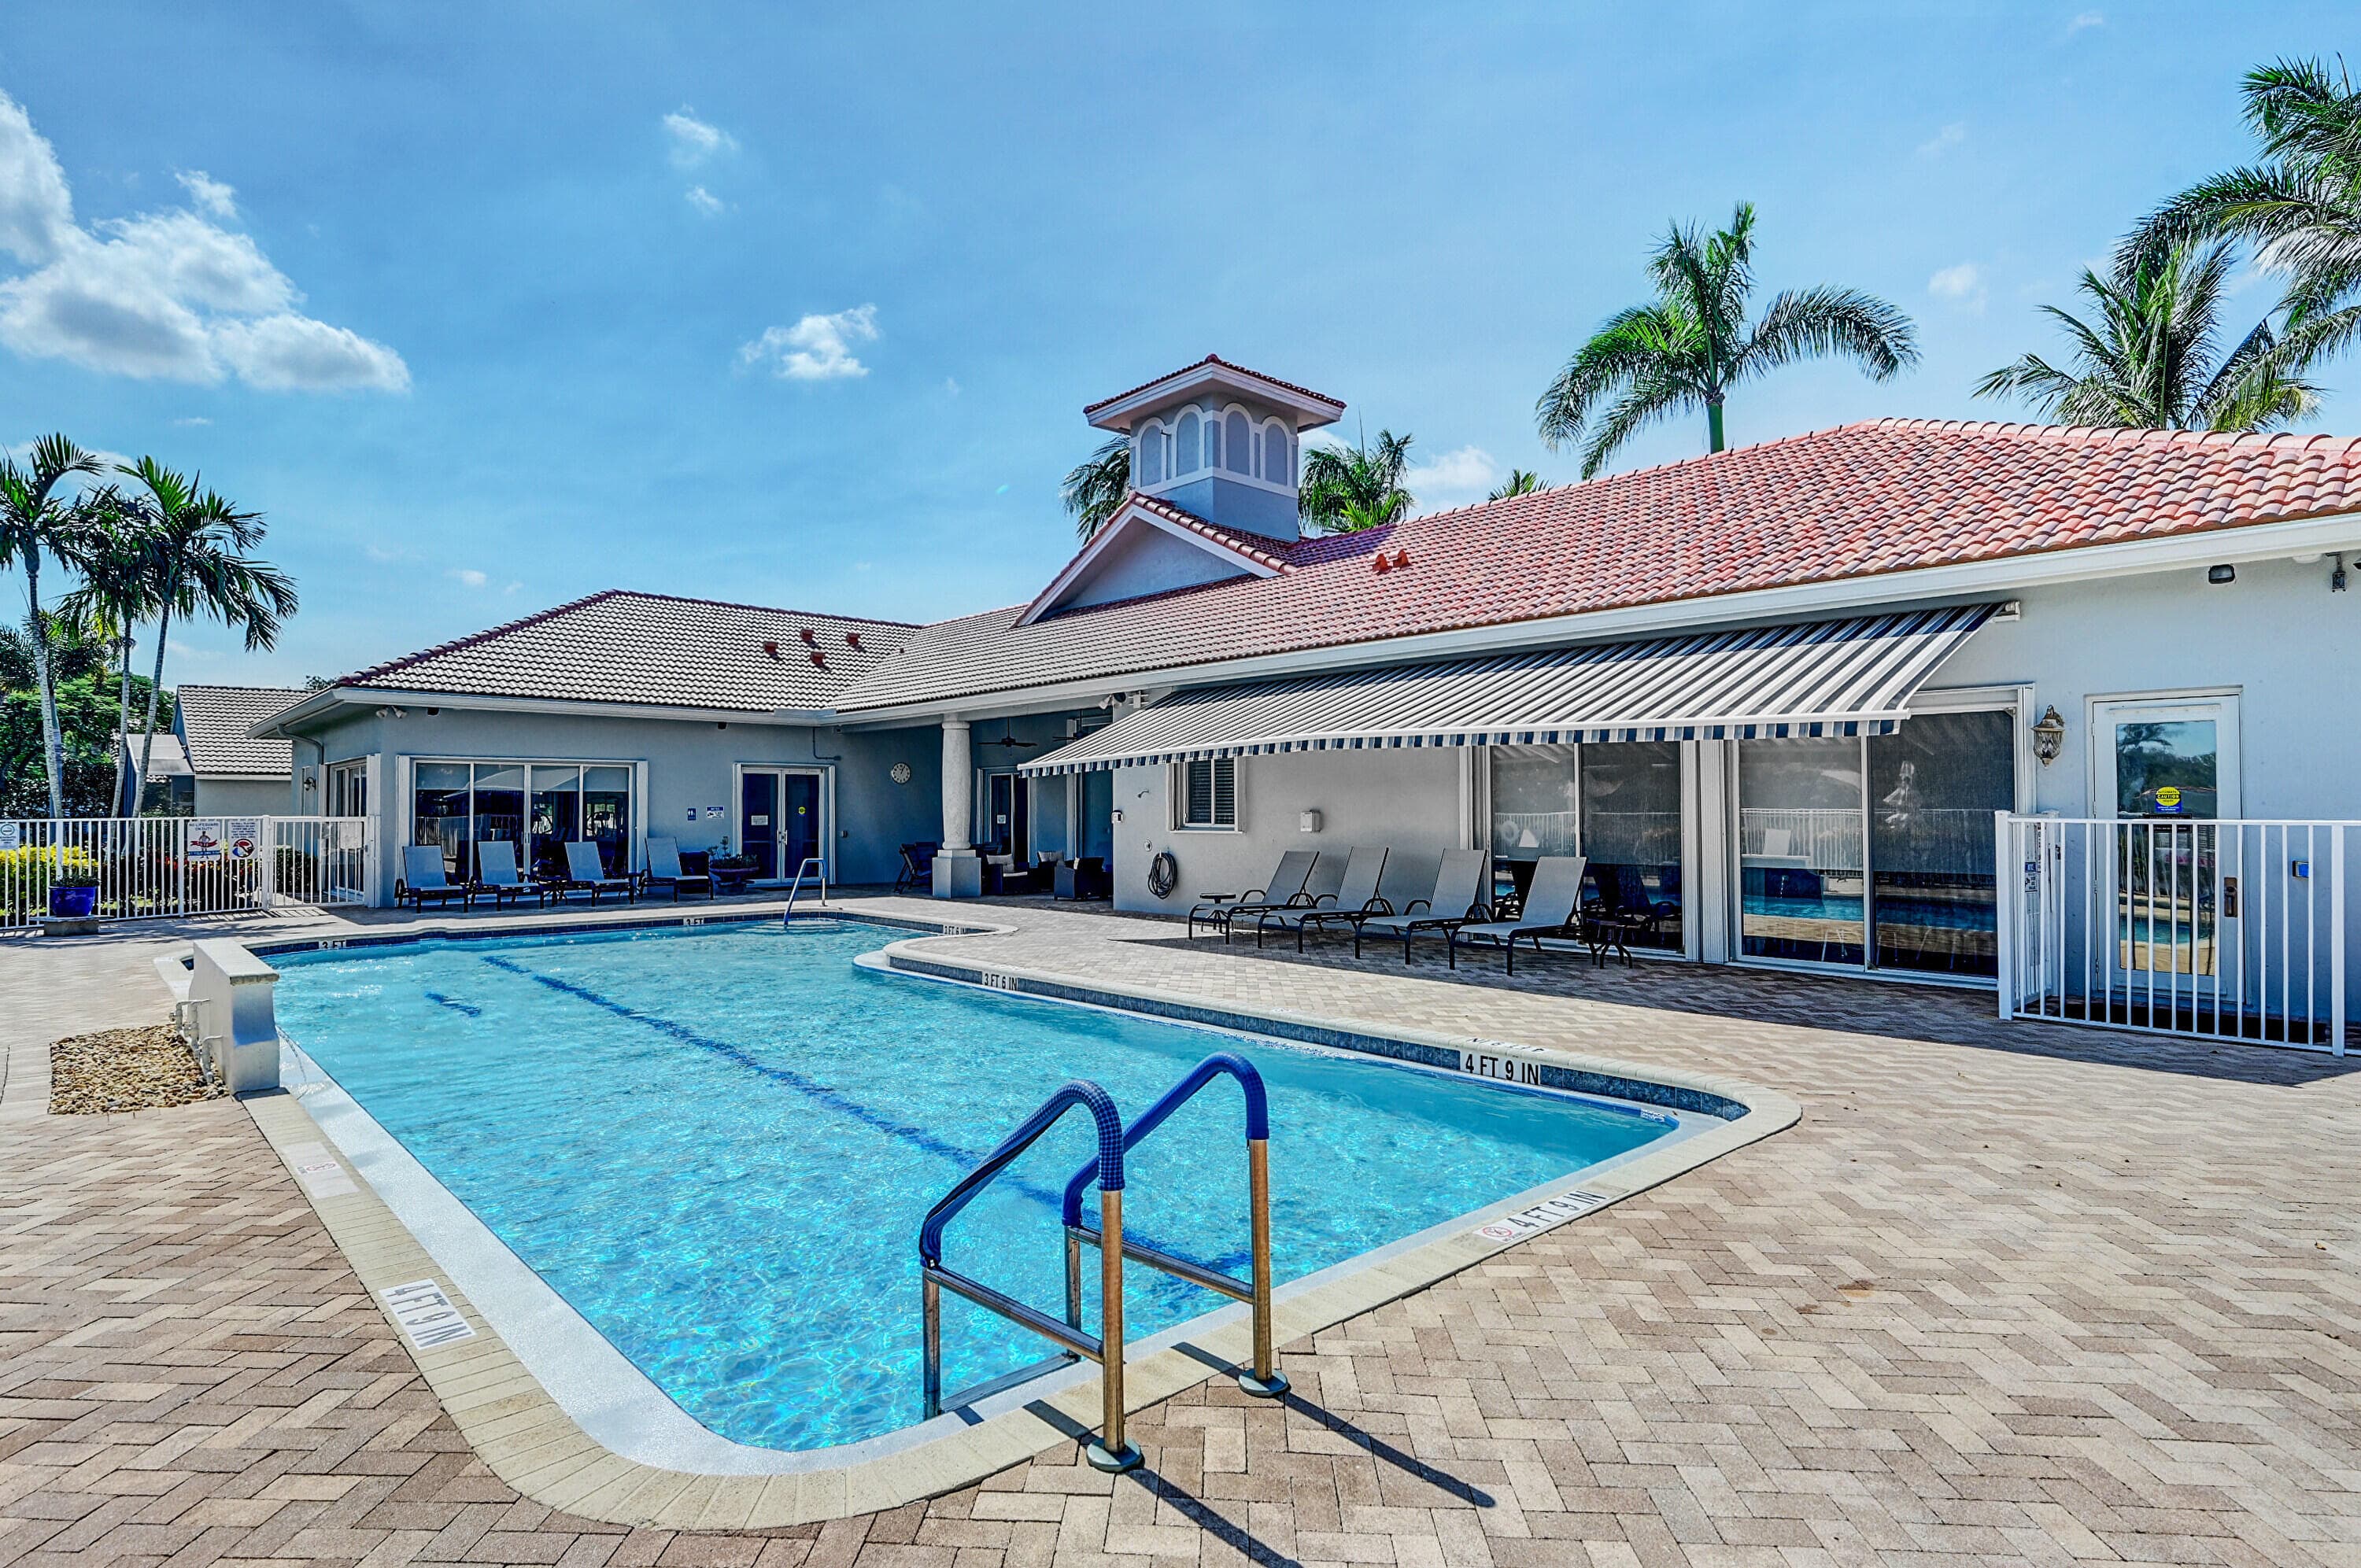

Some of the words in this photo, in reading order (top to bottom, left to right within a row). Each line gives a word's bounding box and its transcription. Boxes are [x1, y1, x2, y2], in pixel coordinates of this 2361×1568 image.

[948, 925, 955, 935] FT
[984, 973, 989, 986] 3
[991, 973, 999, 988] FT
[1002, 976, 1006, 989] 6
[1009, 976, 1018, 991] IN
[1465, 1053, 1474, 1074] 4
[1480, 1055, 1498, 1078] FT
[1506, 1060, 1514, 1081] 9
[1521, 1062, 1539, 1085] IN
[1563, 1190, 1607, 1205] IN
[1549, 1201, 1580, 1211] 9
[1521, 1206, 1565, 1223] FT
[1507, 1217, 1540, 1228] 4
[386, 1284, 434, 1297] 4
[391, 1292, 449, 1314] FT
[405, 1311, 456, 1326] 9
[412, 1322, 471, 1347] IN
